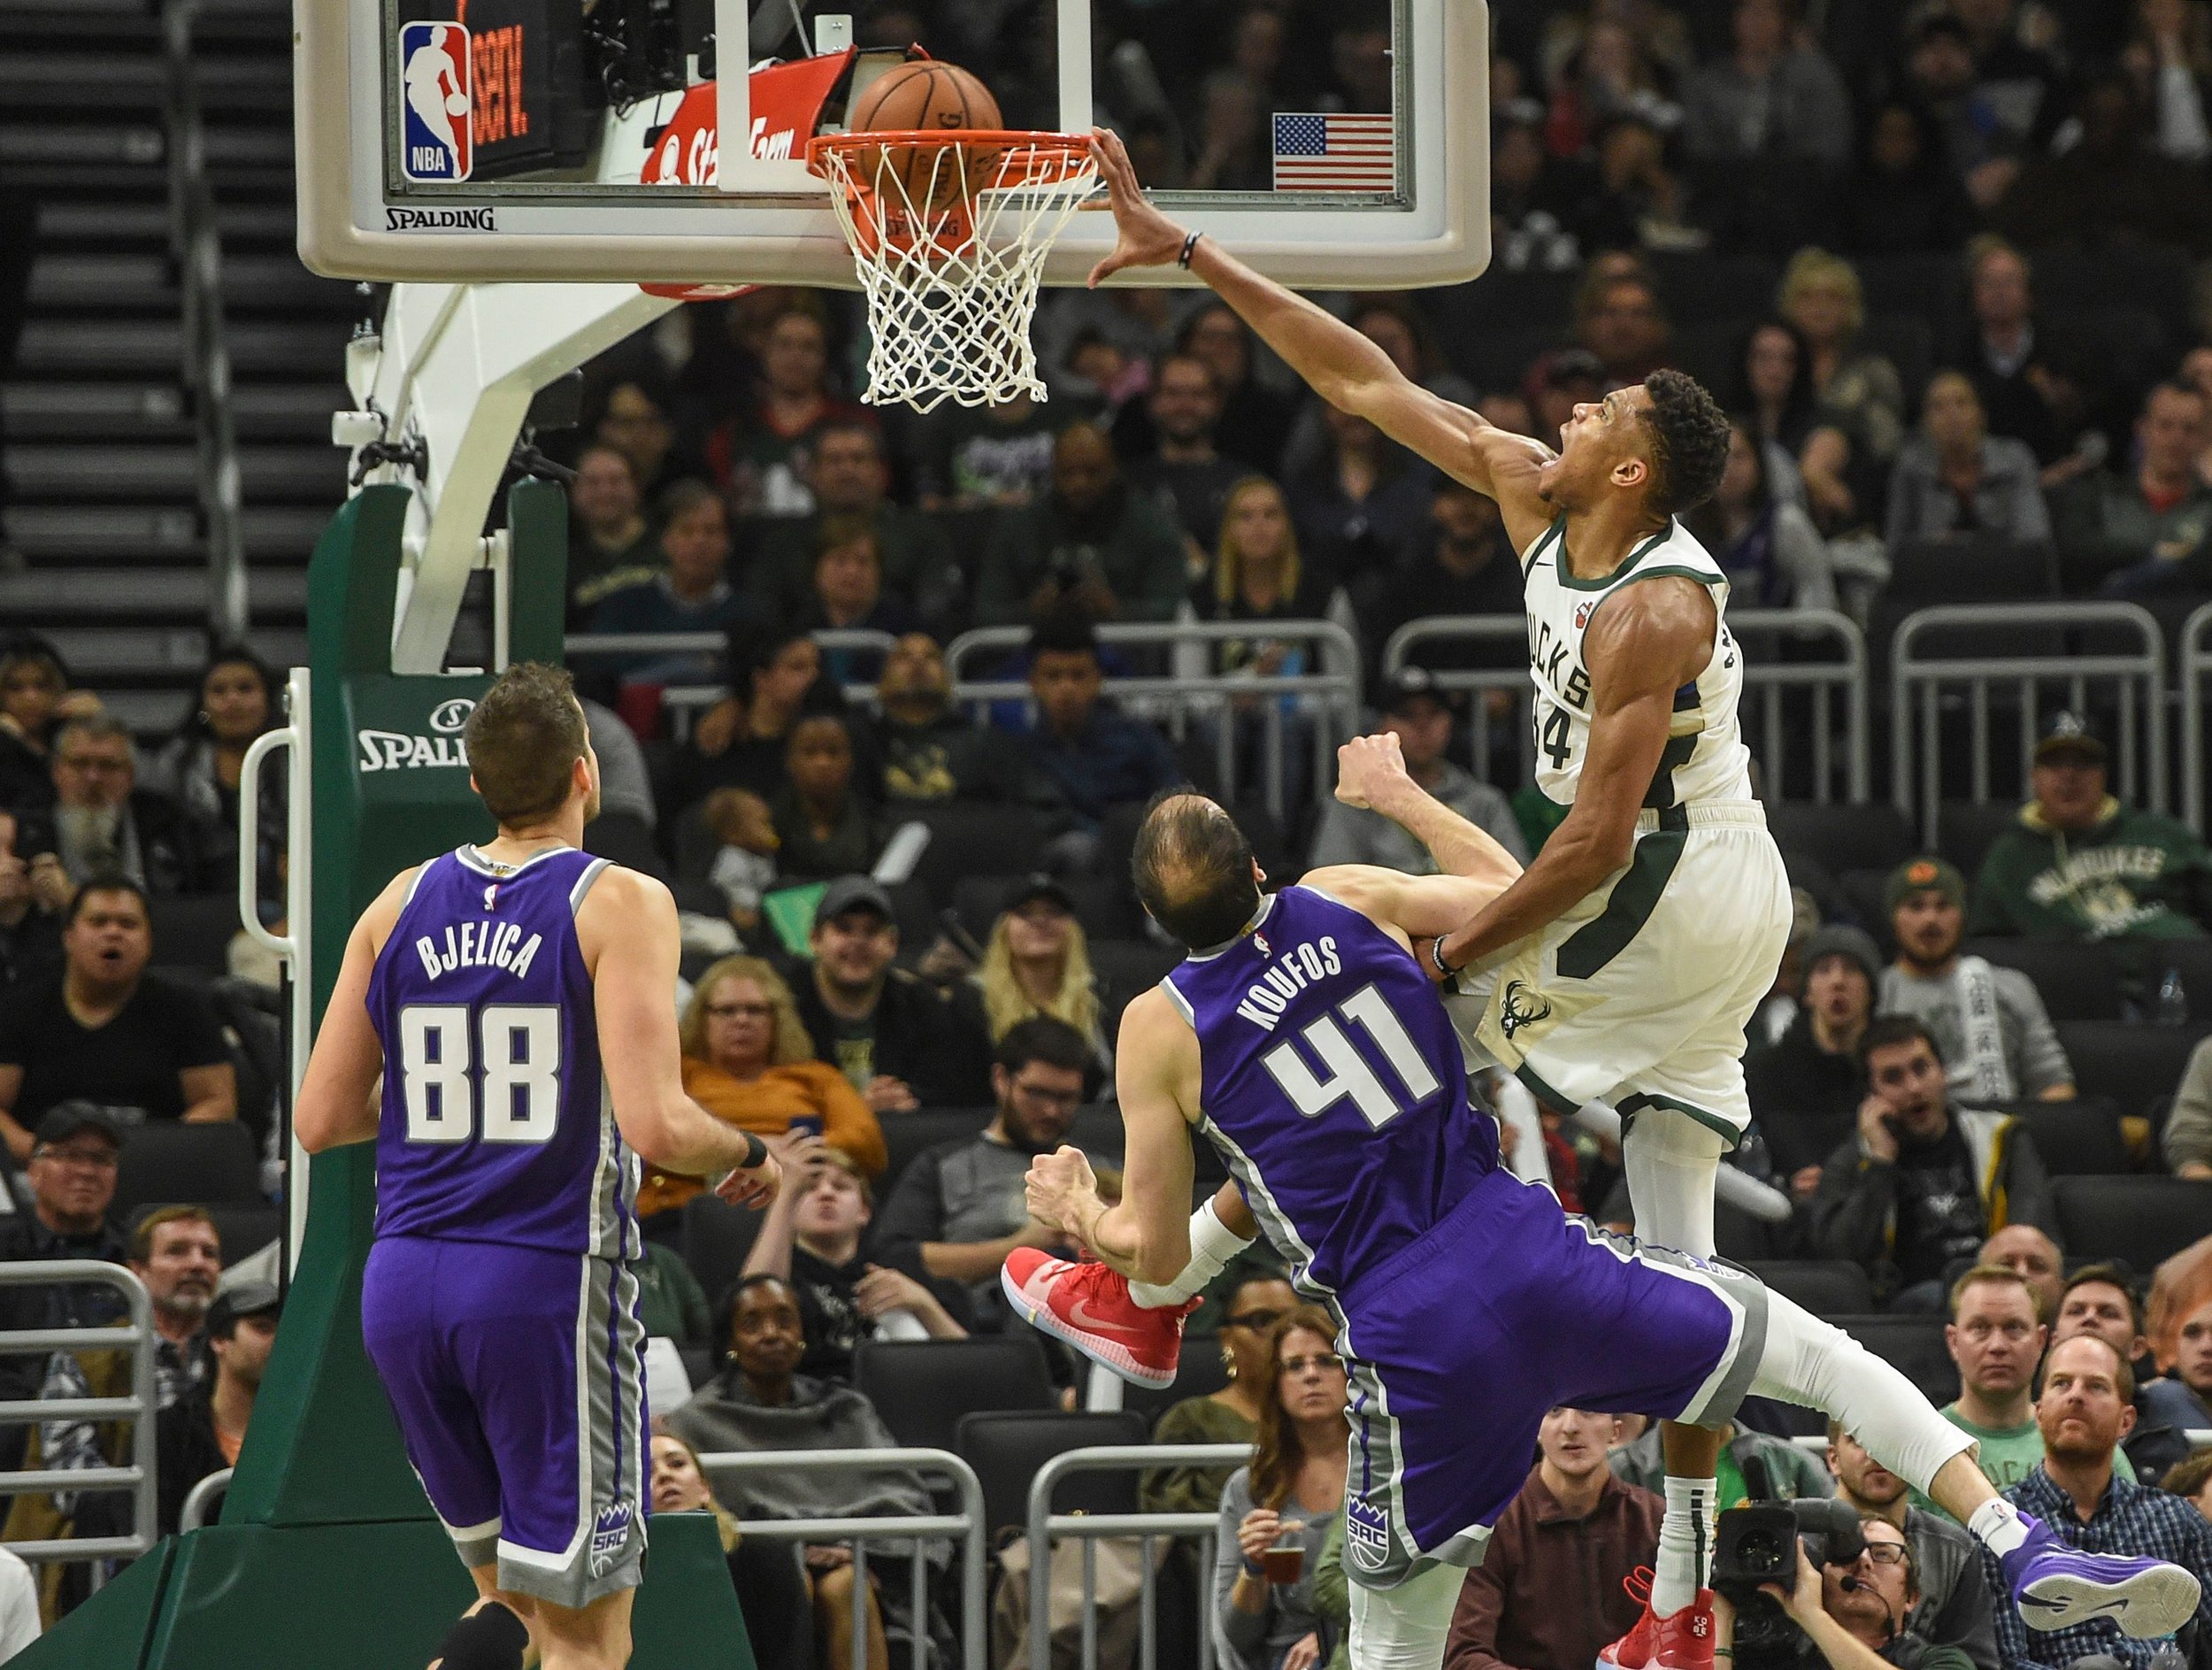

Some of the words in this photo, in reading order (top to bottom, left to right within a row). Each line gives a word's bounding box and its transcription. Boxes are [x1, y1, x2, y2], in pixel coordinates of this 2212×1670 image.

[412, 147, 446, 171] NBA
[386, 207, 496, 231] SPALDING
[358, 729, 470, 773] SPAL
[1535, 697, 1571, 770] 4
[416, 920, 542, 981] BJELICA
[1236, 936, 1341, 1032] KOUFOS
[400, 1004, 561, 1143] 88
[1260, 983, 1443, 1130] 41
[594, 1529, 627, 1551] SAC
[1348, 1519, 1387, 1548] SAC
